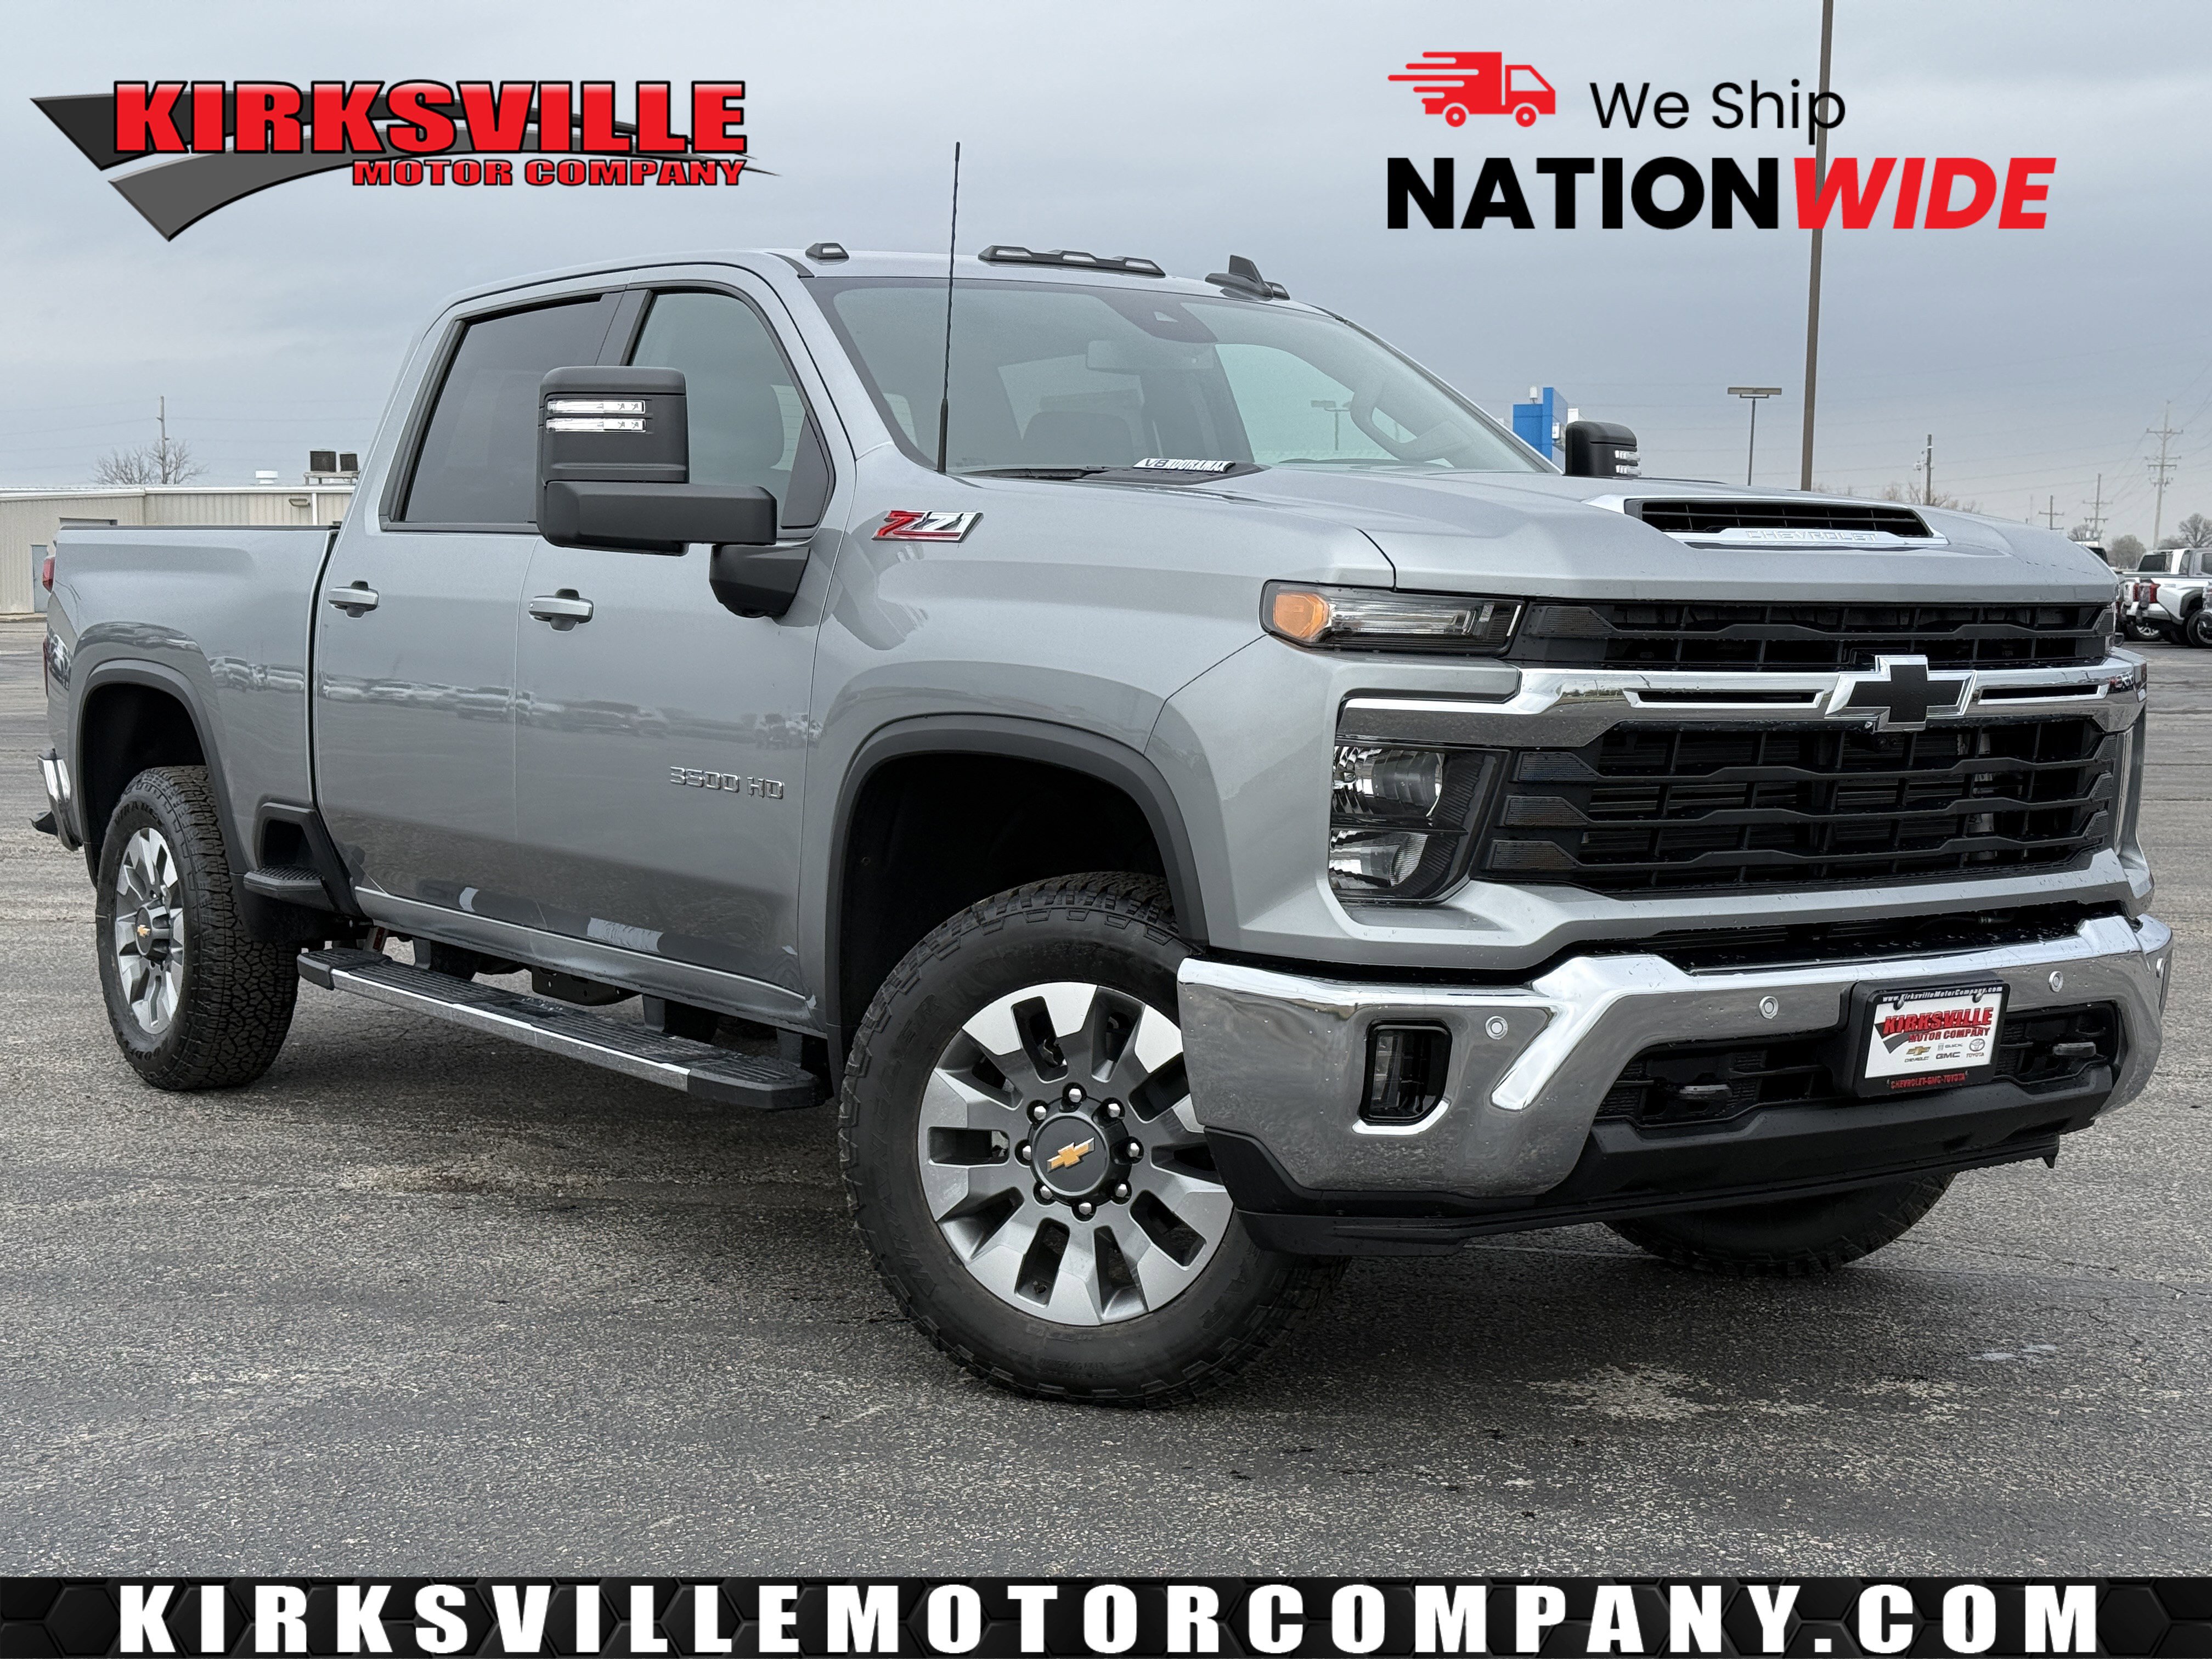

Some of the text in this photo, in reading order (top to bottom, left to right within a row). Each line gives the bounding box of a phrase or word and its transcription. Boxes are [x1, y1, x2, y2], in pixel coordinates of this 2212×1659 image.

[871, 510, 984, 543] Z71
[1746, 530, 1877, 541] CHEVROLET
[669, 766, 785, 800] 3500 HD
[1883, 1007, 1994, 1034] KIRKSVILLE
[1908, 1027, 1991, 1043] MOTOR COMPANY
